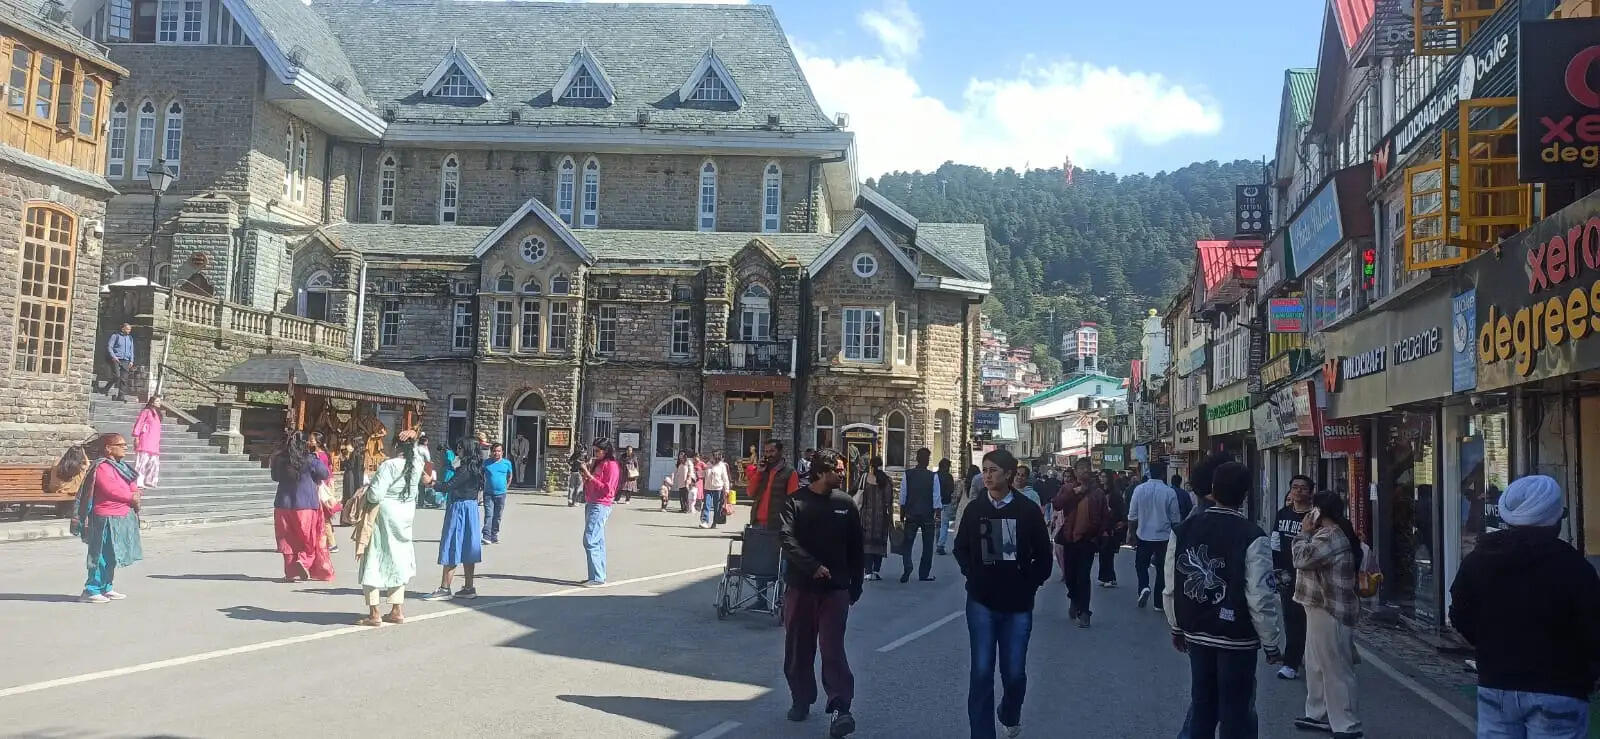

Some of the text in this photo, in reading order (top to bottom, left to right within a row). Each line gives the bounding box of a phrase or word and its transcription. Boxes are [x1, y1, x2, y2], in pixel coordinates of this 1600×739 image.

[1477, 34, 1509, 80] bake
[1527, 217, 1600, 294] xero
[1343, 346, 1386, 379] WILDCRAFT
[1324, 424, 1360, 436] SHREE
[1279, 519, 1303, 534] SAN DIE
